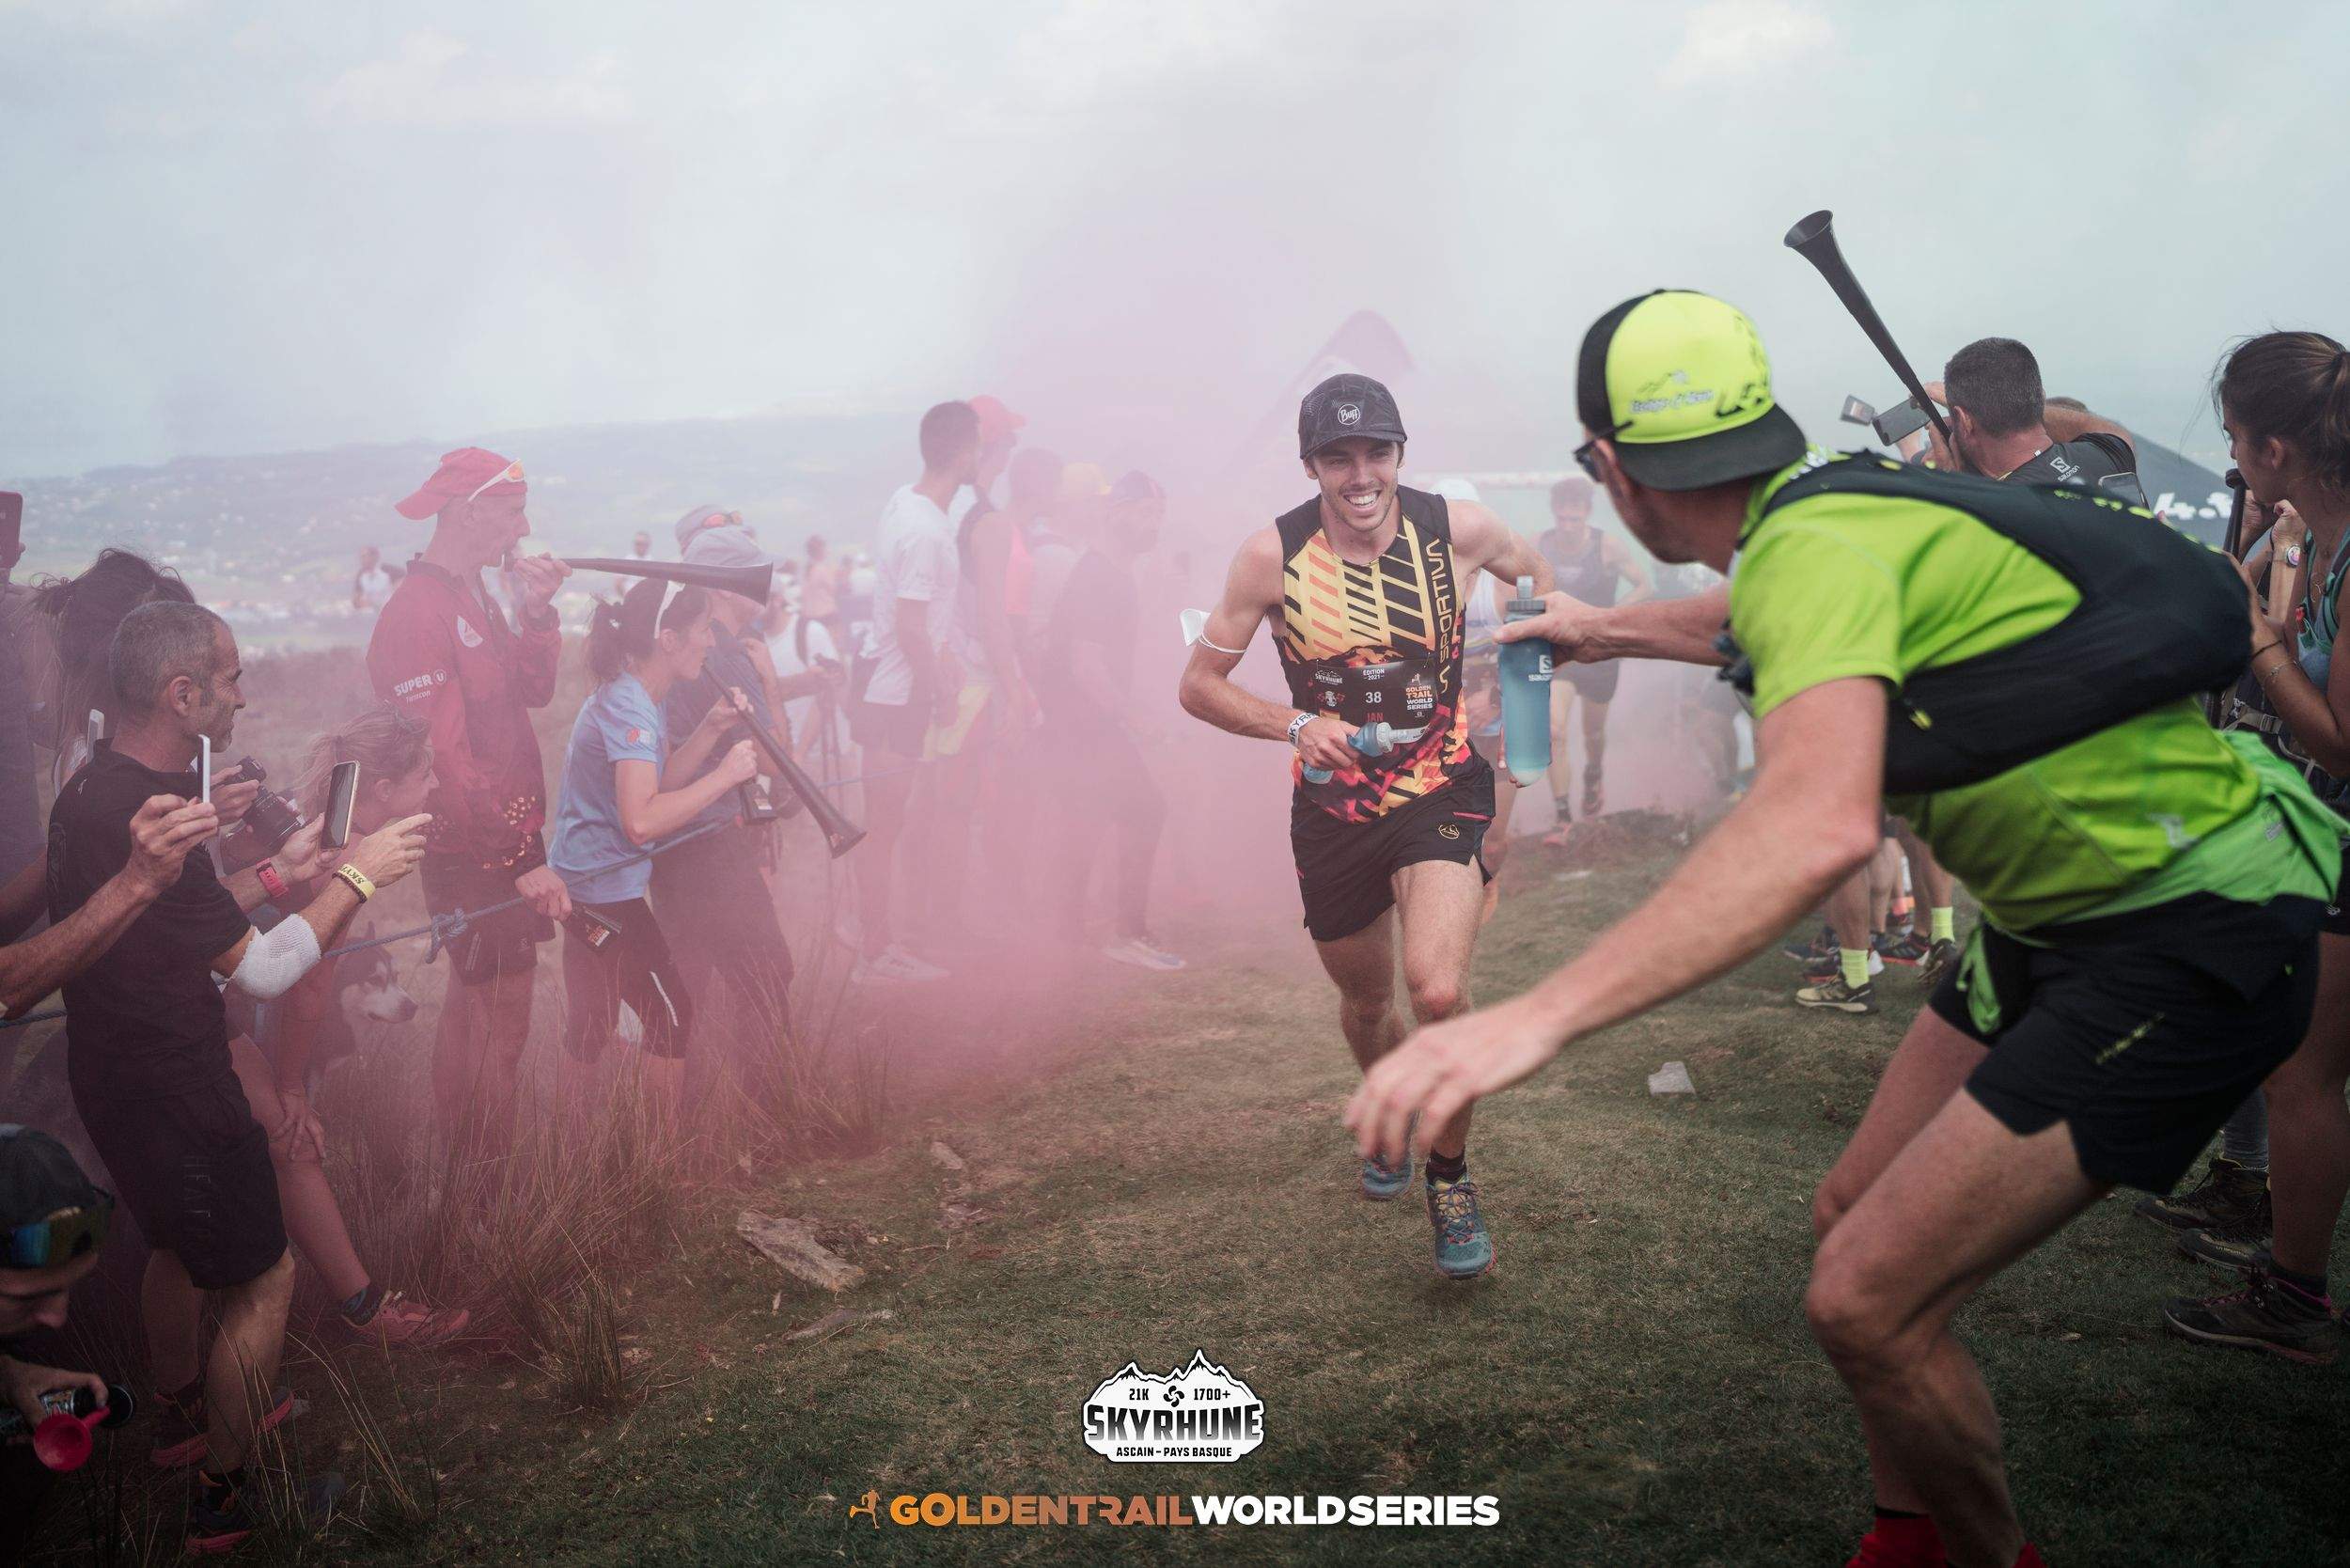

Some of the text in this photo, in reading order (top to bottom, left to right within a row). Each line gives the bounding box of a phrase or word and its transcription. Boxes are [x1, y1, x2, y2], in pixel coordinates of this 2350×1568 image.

[1340, 408, 1359, 423] Buff
[1426, 538, 1452, 664] SPORTIVA
[394, 674, 433, 697] SUPER
[1366, 692, 1382, 703] 38
